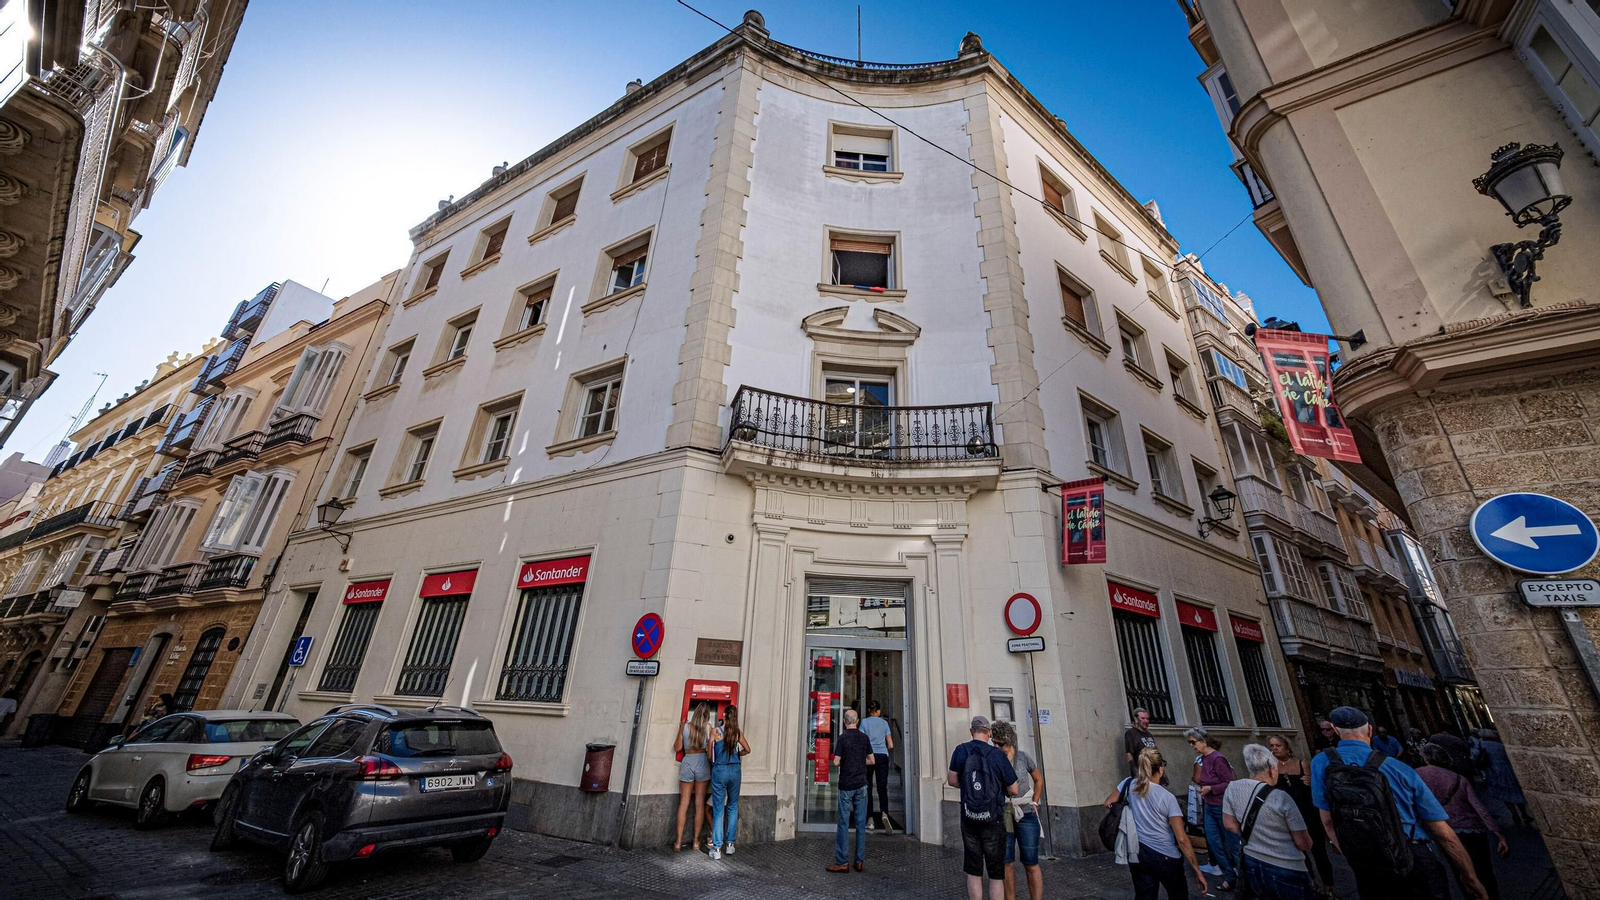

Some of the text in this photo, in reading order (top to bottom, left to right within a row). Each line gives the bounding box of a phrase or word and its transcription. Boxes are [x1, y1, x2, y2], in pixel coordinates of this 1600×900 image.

[1281, 387, 1300, 401] de
[1076, 506, 1100, 519] latido
[1066, 518, 1100, 530] de Cádiz
[534, 566, 583, 582] Santander
[354, 587, 384, 599] Santander
[1527, 583, 1594, 592] EXCEPTO
[1122, 593, 1157, 612] Santander
[1544, 593, 1587, 602] TAXIS
[1240, 624, 1261, 637] Santander
[427, 776, 474, 788] 6902 JWN
